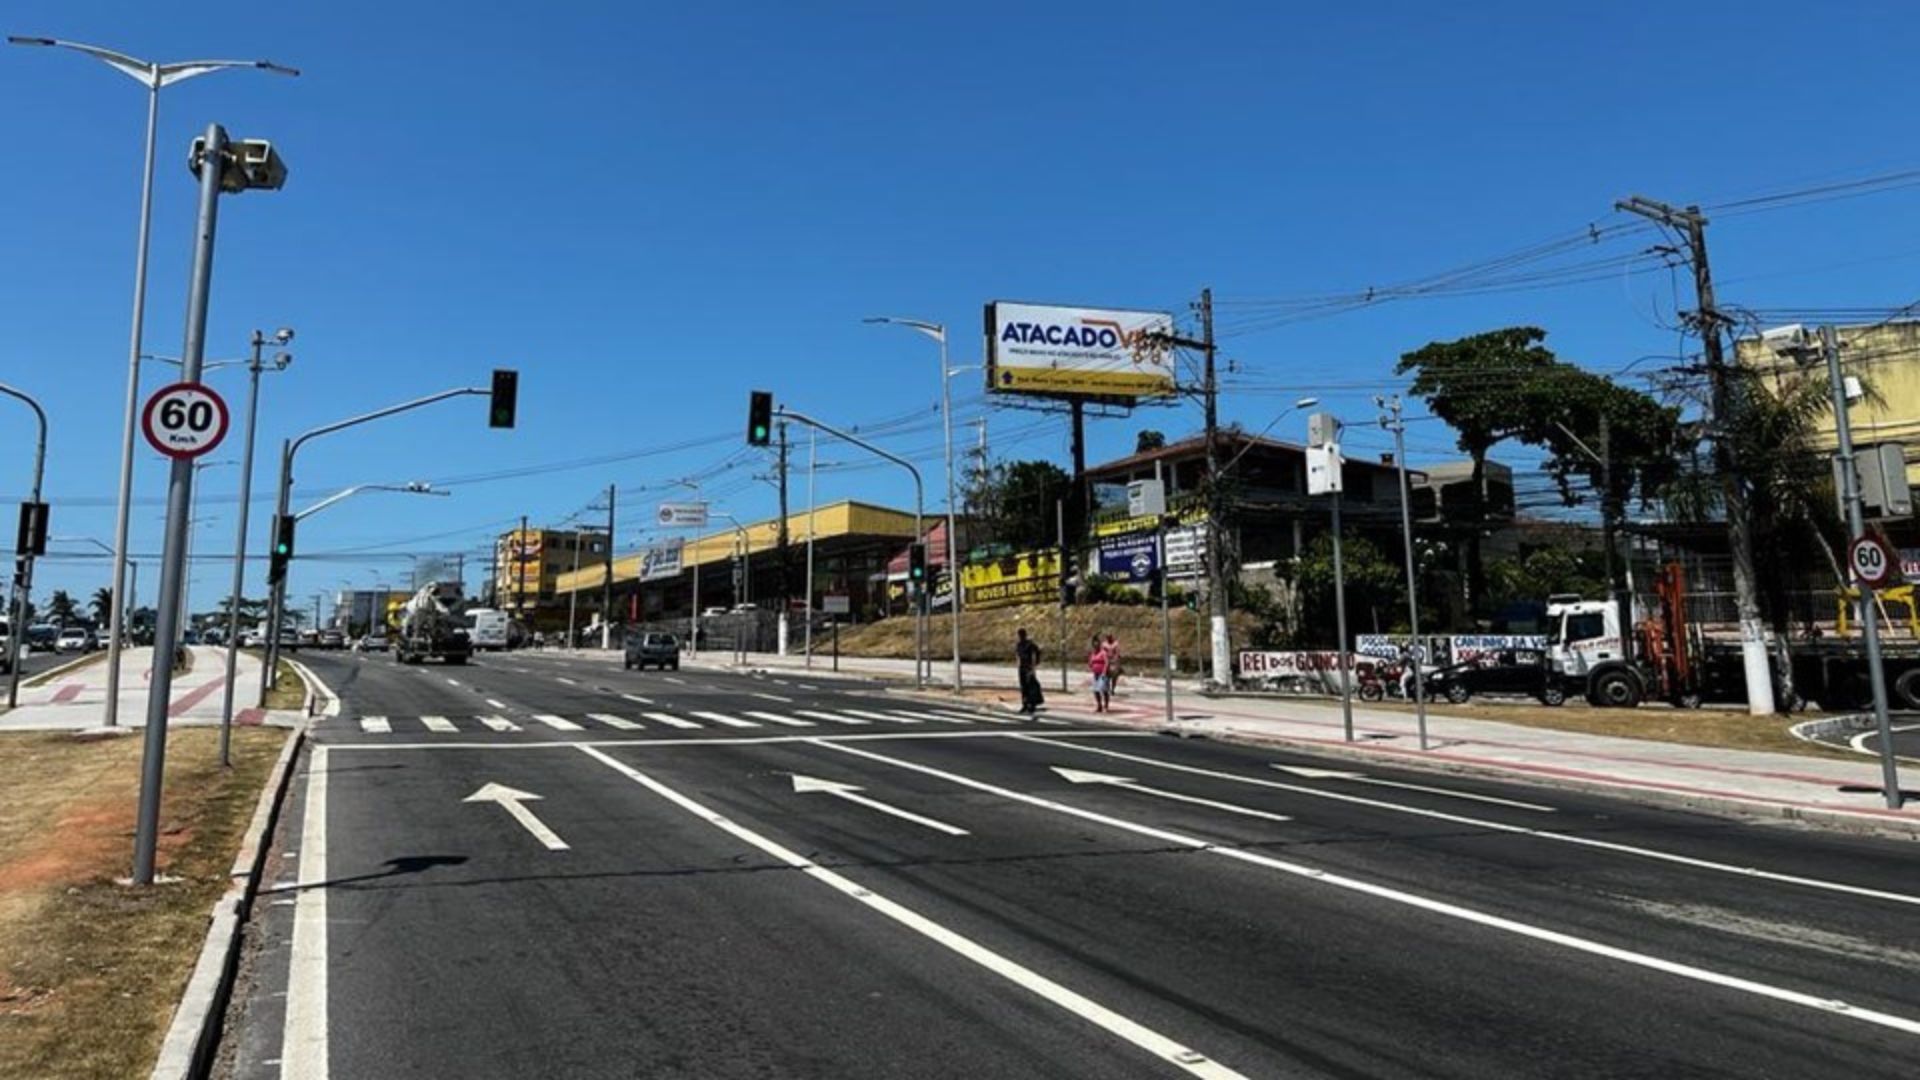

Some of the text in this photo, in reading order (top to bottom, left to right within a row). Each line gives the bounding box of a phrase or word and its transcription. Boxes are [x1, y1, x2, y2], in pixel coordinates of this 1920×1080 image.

[1002, 322, 1117, 349] ATACADO
[160, 398, 213, 432] 60
[1857, 547, 1881, 567] 60
[1243, 653, 1266, 671] REI
